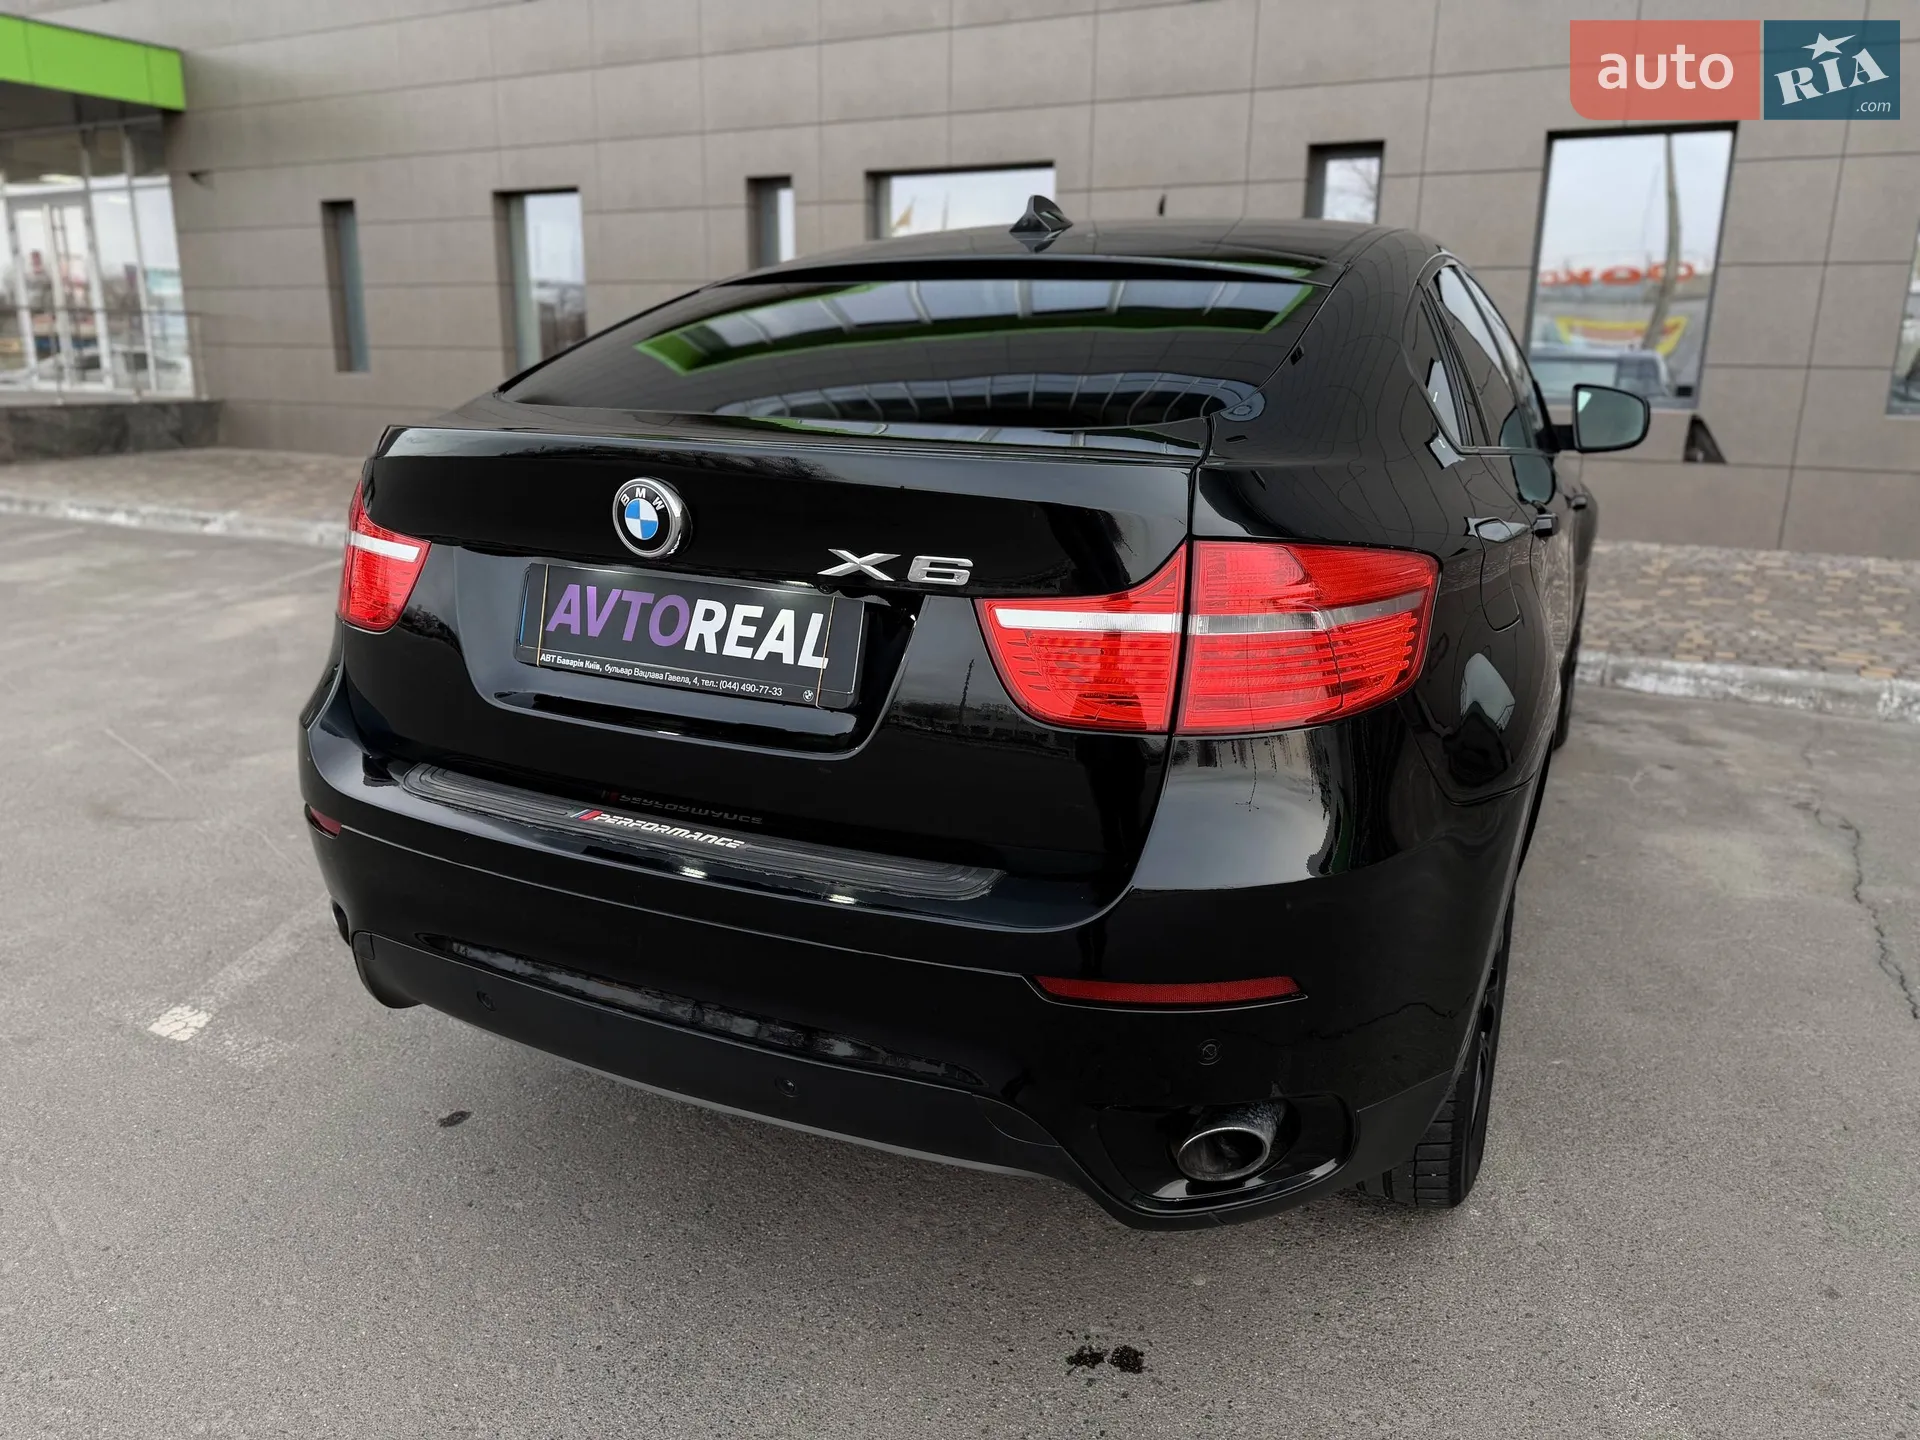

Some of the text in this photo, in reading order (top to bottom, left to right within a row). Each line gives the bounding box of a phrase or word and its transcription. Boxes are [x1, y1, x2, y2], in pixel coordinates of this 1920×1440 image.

[621, 487, 665, 511] BMW
[546, 584, 830, 669] AVTOREAL
[540, 653, 556, 662] АВТ
[556, 656, 584, 667] Баварія
[584, 660, 602, 672] Київ,
[604, 663, 632, 676] бульвар
[633, 667, 664, 680] Вацлава
[664, 672, 691, 685] Гавела,
[719, 680, 740, 692] (044)
[741, 683, 783, 696] 490-77-33
[593, 813, 746, 849] PERFORMANCE
